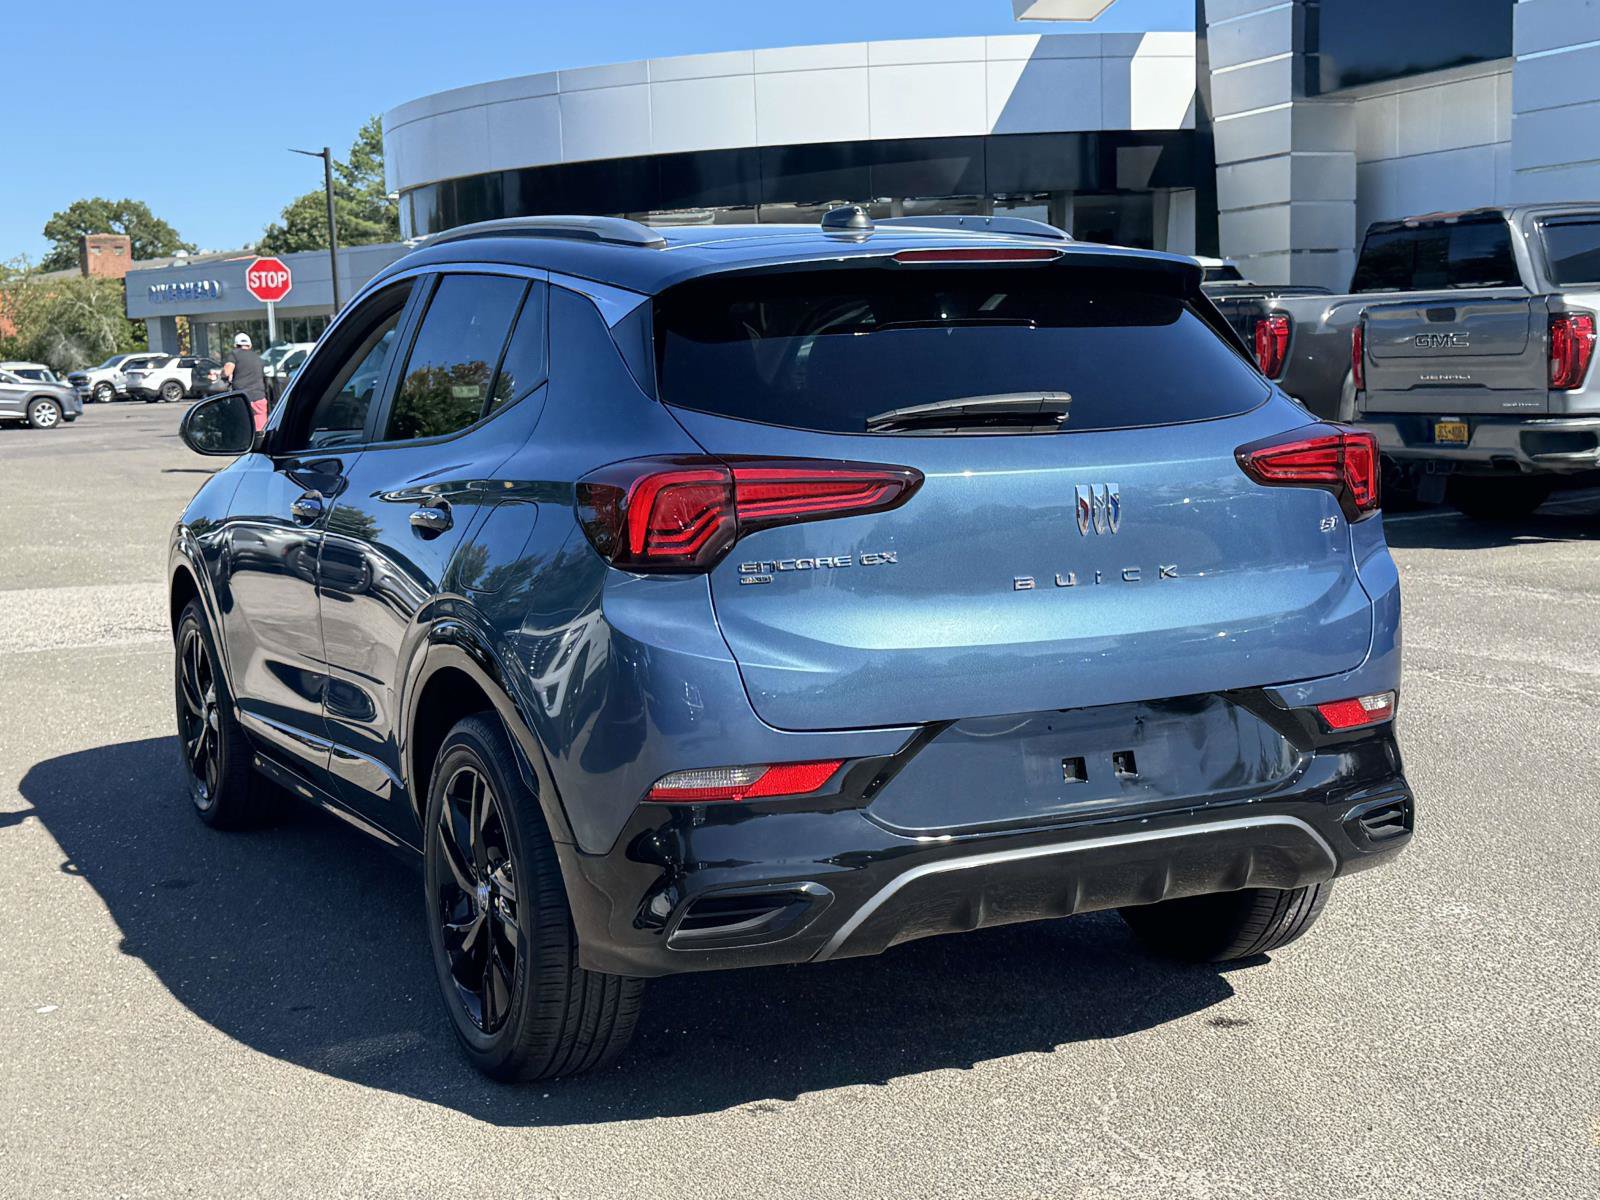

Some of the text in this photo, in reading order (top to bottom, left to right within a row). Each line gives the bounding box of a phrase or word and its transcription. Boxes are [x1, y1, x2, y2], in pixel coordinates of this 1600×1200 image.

[250, 271, 288, 288] STOP
[1414, 332, 1470, 348] GMC
[738, 551, 898, 573] ENCORE EX
[1013, 563, 1179, 592] BUICK
